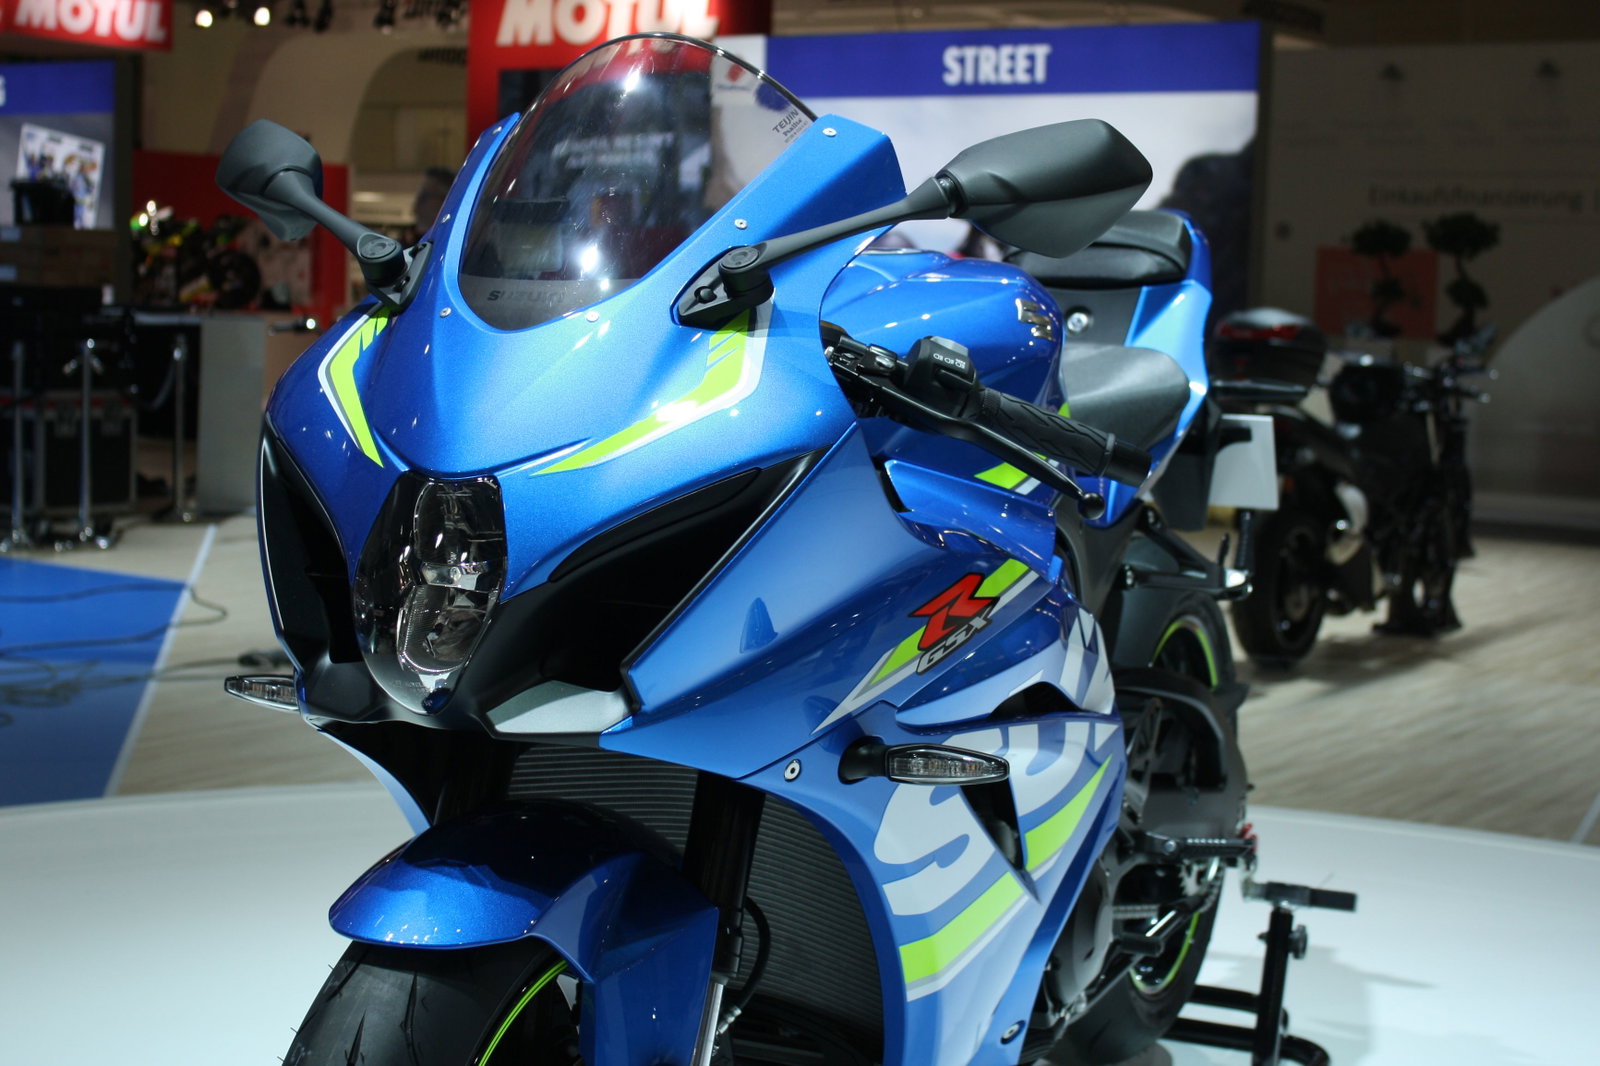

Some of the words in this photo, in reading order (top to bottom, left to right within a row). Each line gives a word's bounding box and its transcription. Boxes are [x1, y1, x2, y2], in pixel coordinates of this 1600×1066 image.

[15, 0, 167, 43] MOTUL
[496, 0, 718, 48] MOTUL
[942, 43, 1052, 86] STREET
[772, 108, 799, 133] TEIJIN
[487, 289, 566, 304] SUZUKI
[915, 606, 991, 674] GSX
